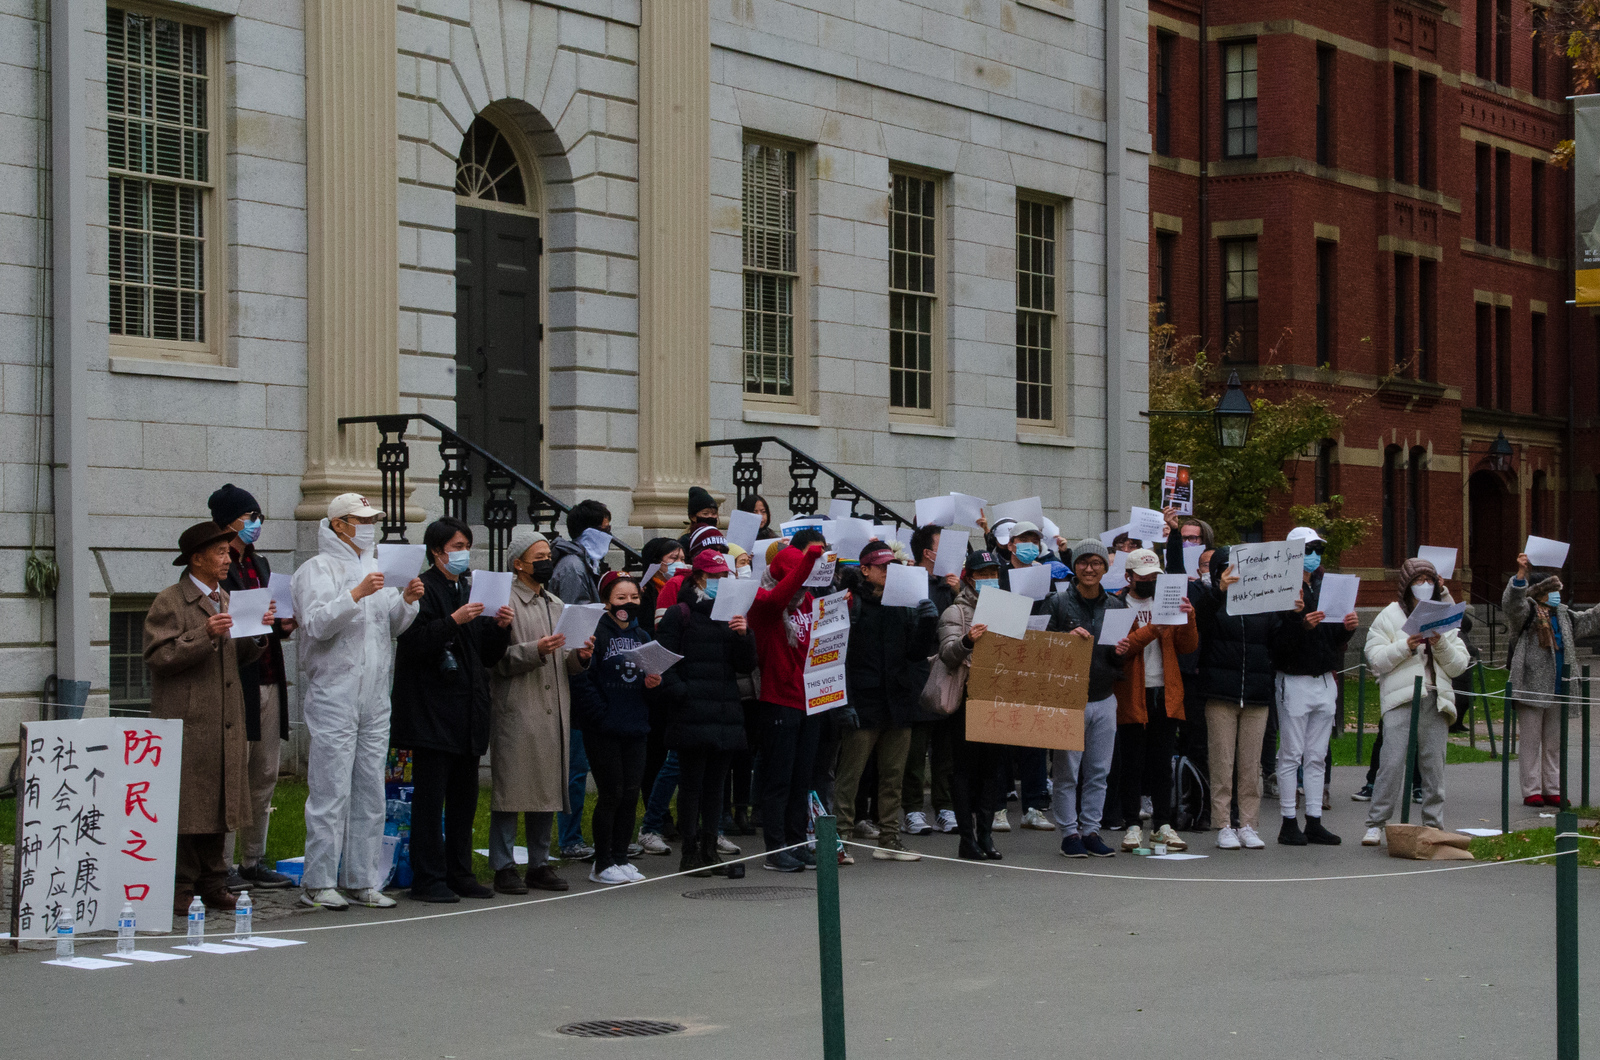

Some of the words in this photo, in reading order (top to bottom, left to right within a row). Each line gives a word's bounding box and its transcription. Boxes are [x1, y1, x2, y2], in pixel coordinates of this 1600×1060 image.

[1236, 548, 1270, 574] Freedom
[1274, 550, 1281, 562] of
[813, 615, 840, 630] STUDENTS
[814, 633, 843, 647] SCHOLARS
[1045, 634, 1072, 649] fear
[809, 642, 846, 656] ASSOCIATION
[994, 663, 1009, 674] Do
[807, 679, 821, 689] THIS
[822, 676, 836, 685] VIGIL
[820, 685, 833, 694] NOT
[994, 695, 1007, 708] Do
[1010, 700, 1026, 708] not
[121, 730, 162, 901] 防民之口
[19, 738, 45, 931] 只有一种声音
[41, 737, 79, 932] 社会不应该
[71, 744, 108, 927] 一个健康的
